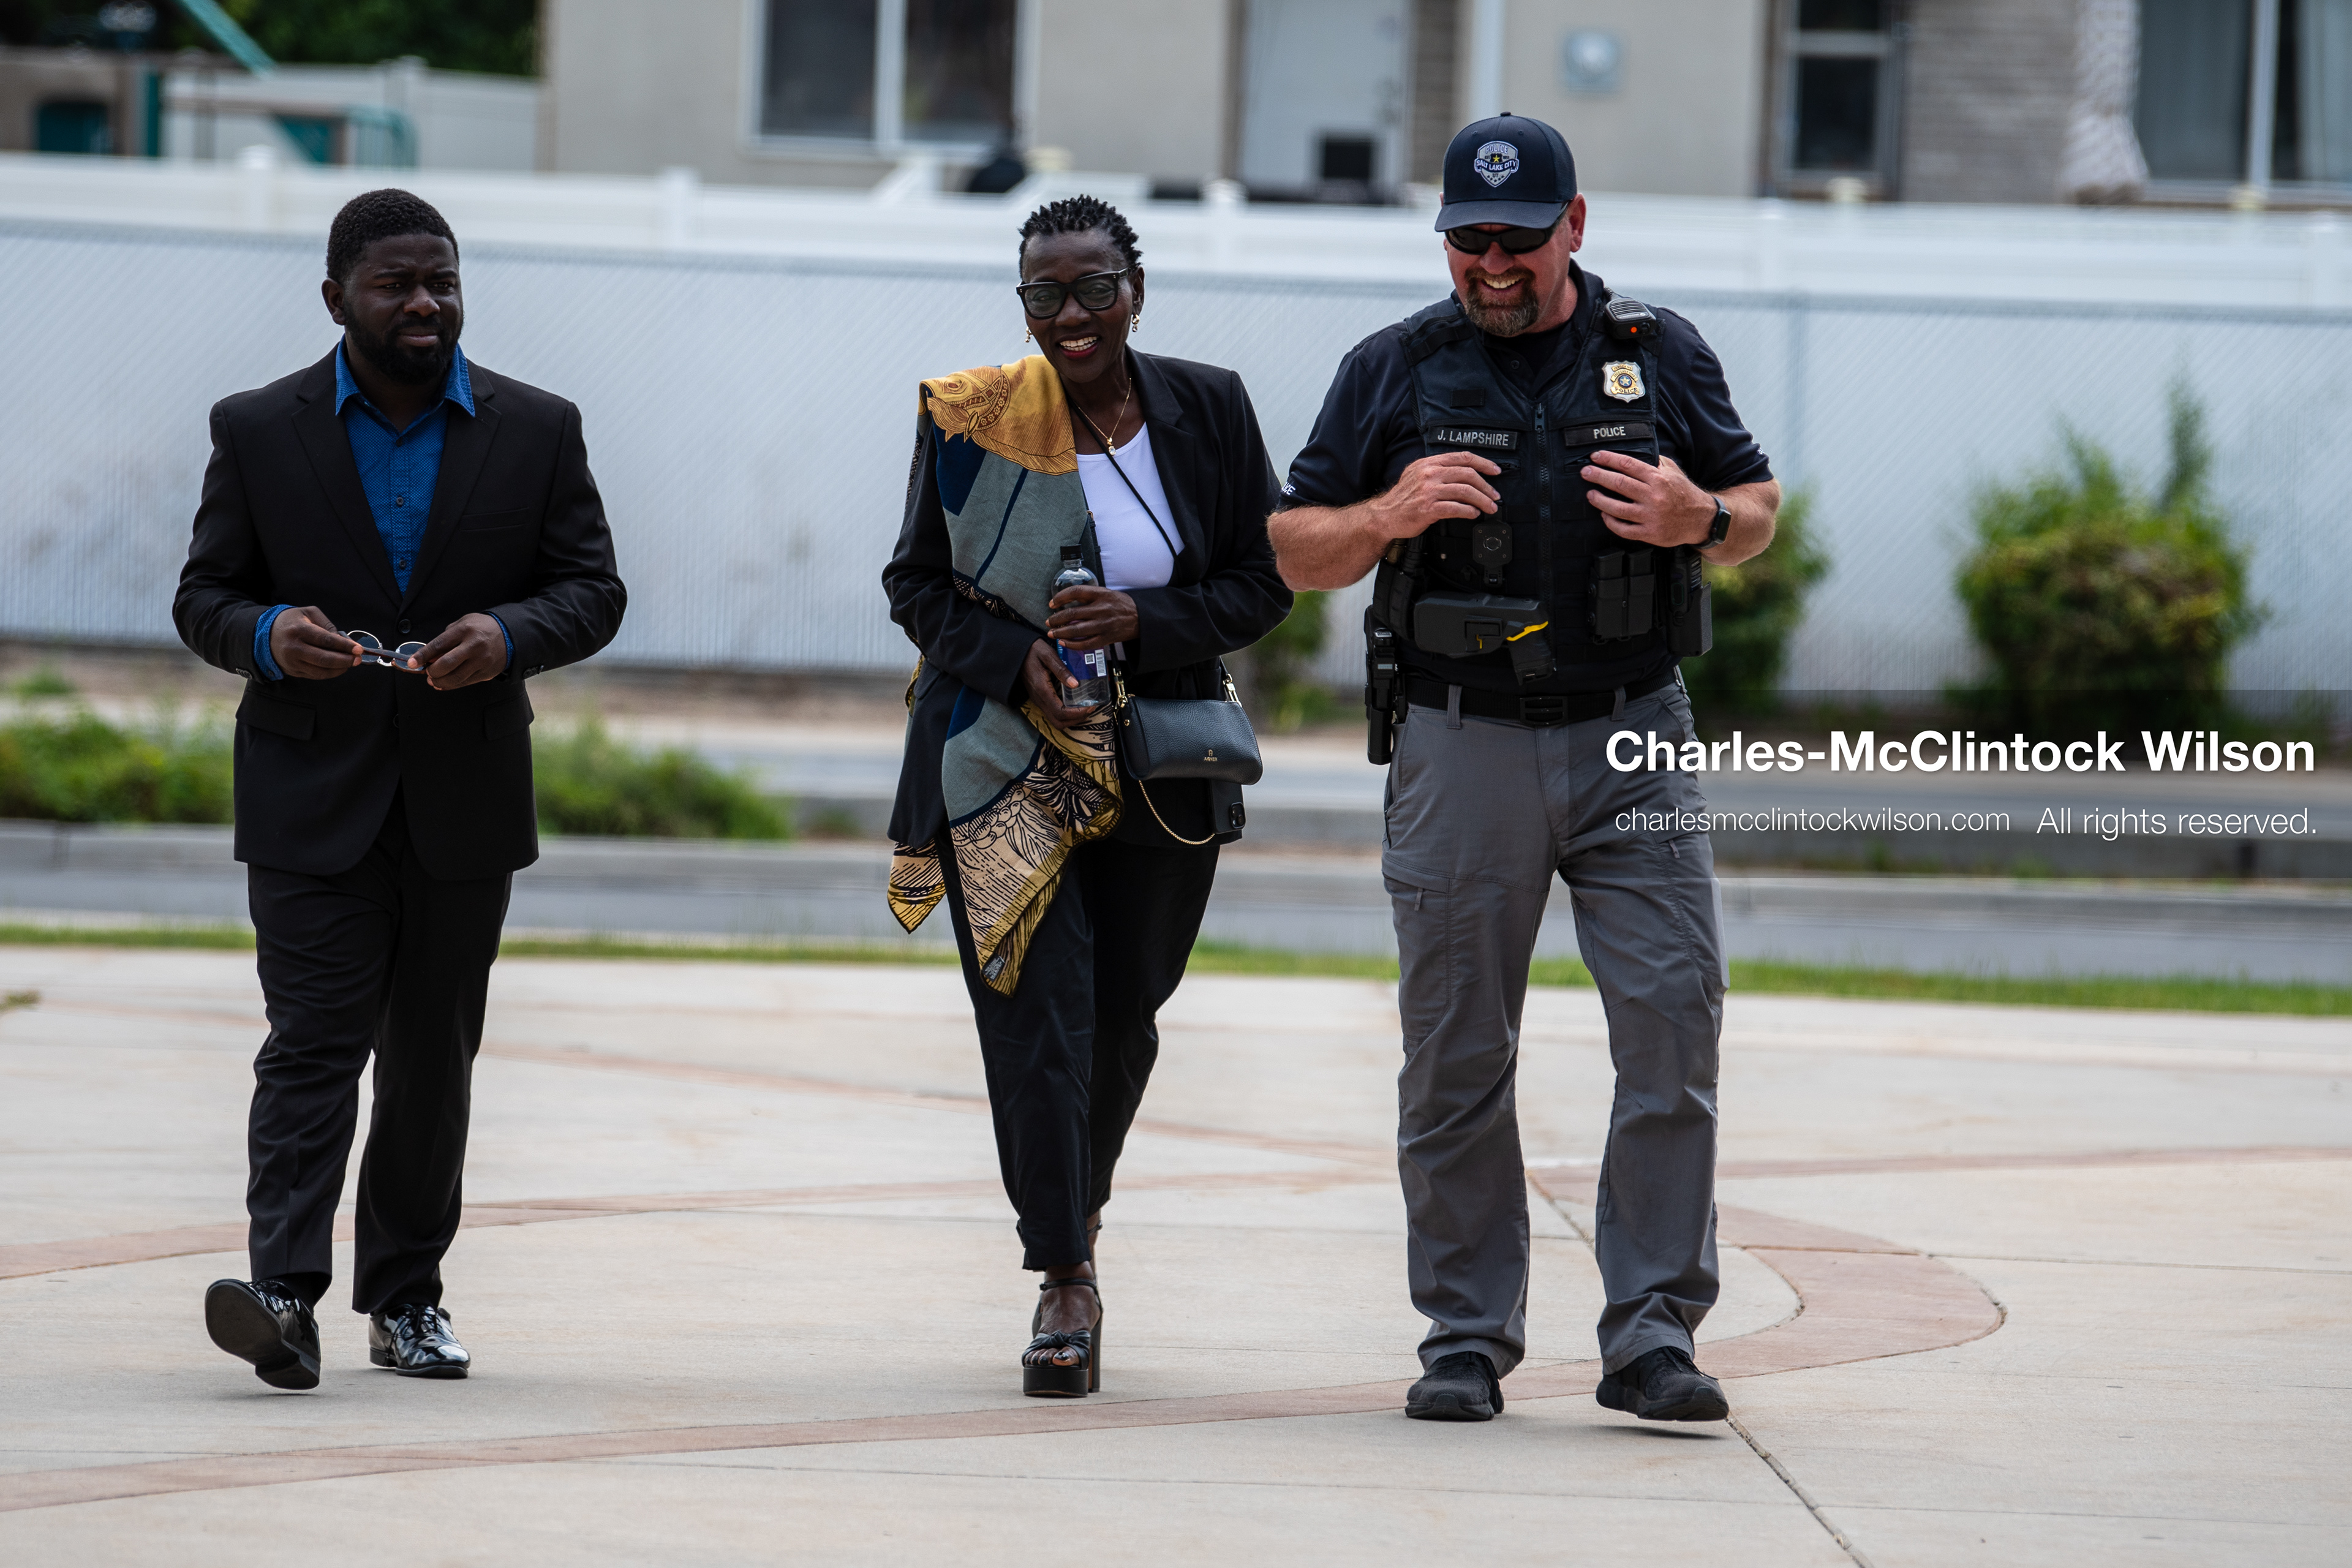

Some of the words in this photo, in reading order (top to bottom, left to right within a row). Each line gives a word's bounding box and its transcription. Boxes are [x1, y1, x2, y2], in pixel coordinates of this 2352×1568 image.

[1485, 144, 1509, 154] POLICE
[1477, 160, 1488, 168] SALT
[1438, 429, 1446, 440] J.
[1449, 431, 1509, 446] LAMPSHIRE
[1593, 426, 1626, 439] POLICE
